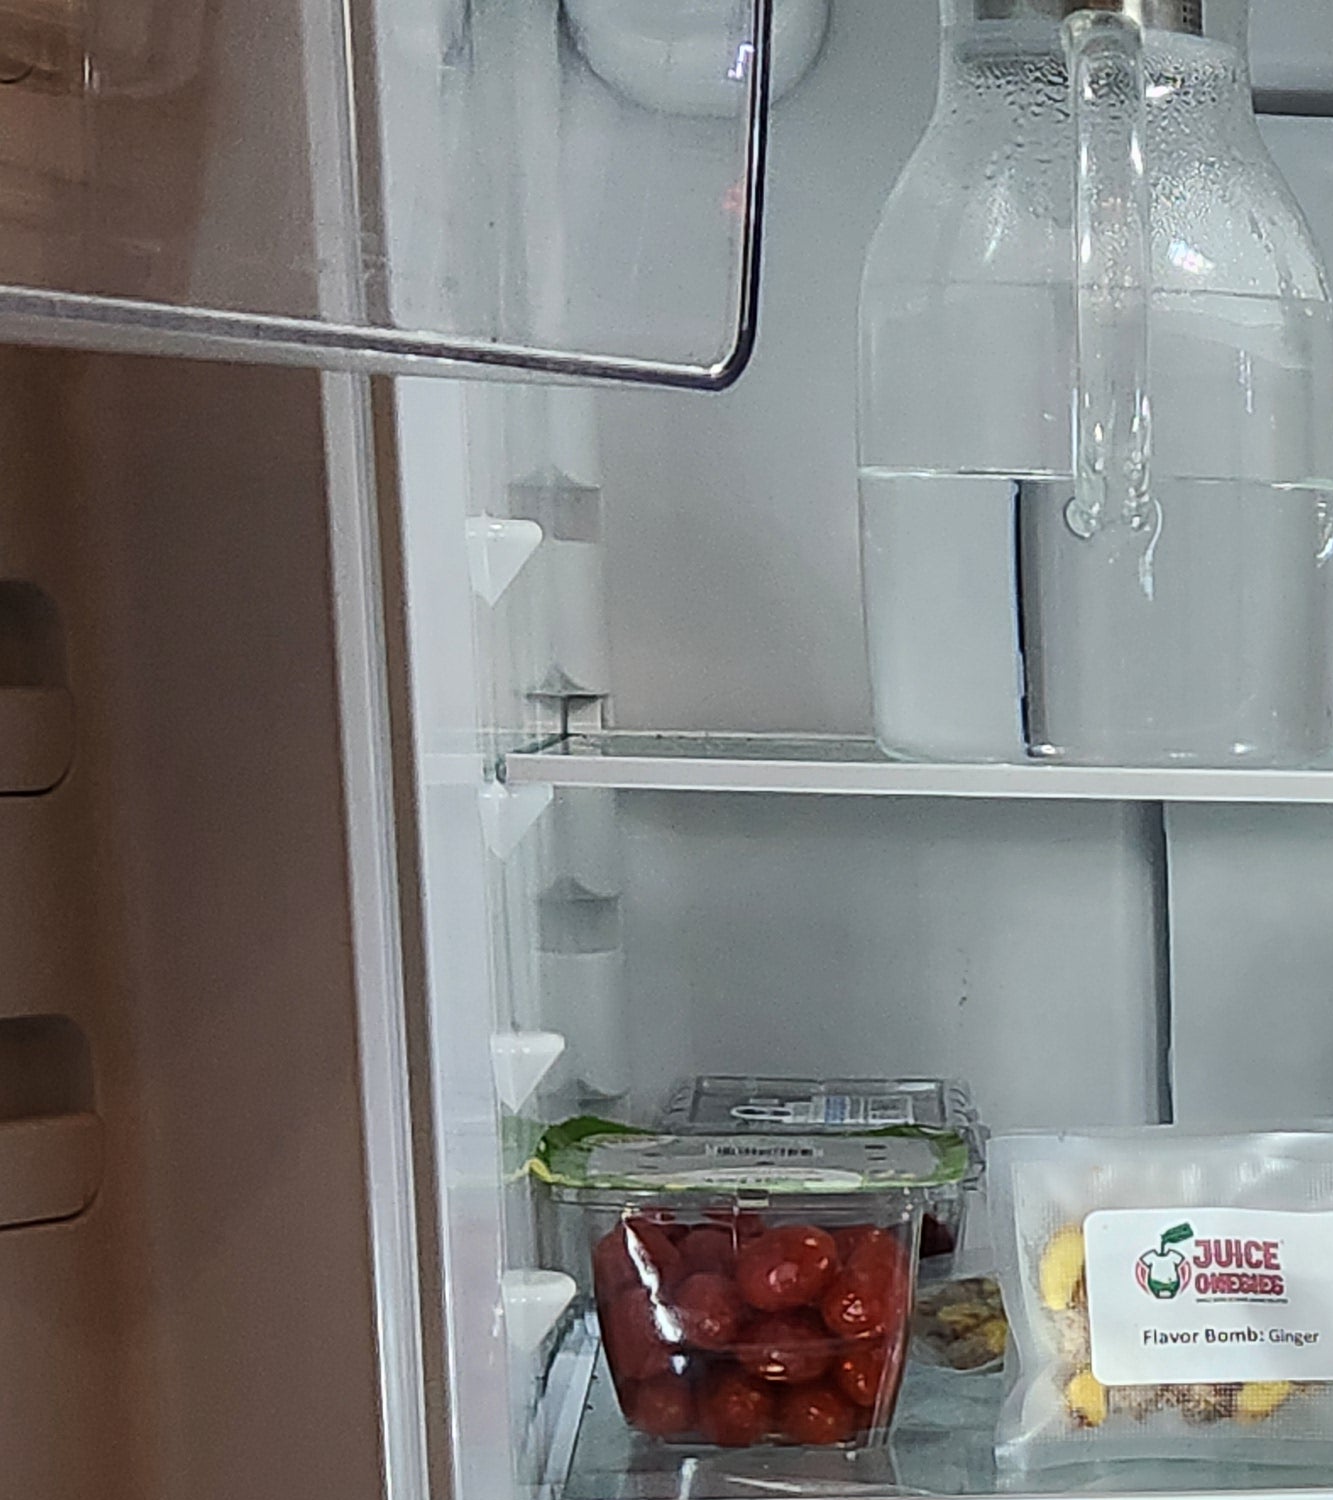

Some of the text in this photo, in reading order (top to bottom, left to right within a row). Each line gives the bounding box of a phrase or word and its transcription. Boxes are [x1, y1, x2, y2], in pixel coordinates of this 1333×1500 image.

[1192, 1239, 1281, 1270] JUICE
[1194, 1272, 1285, 1296] ONESIES
[1143, 1328, 1319, 1346] Flavor Bomb: Ginger
